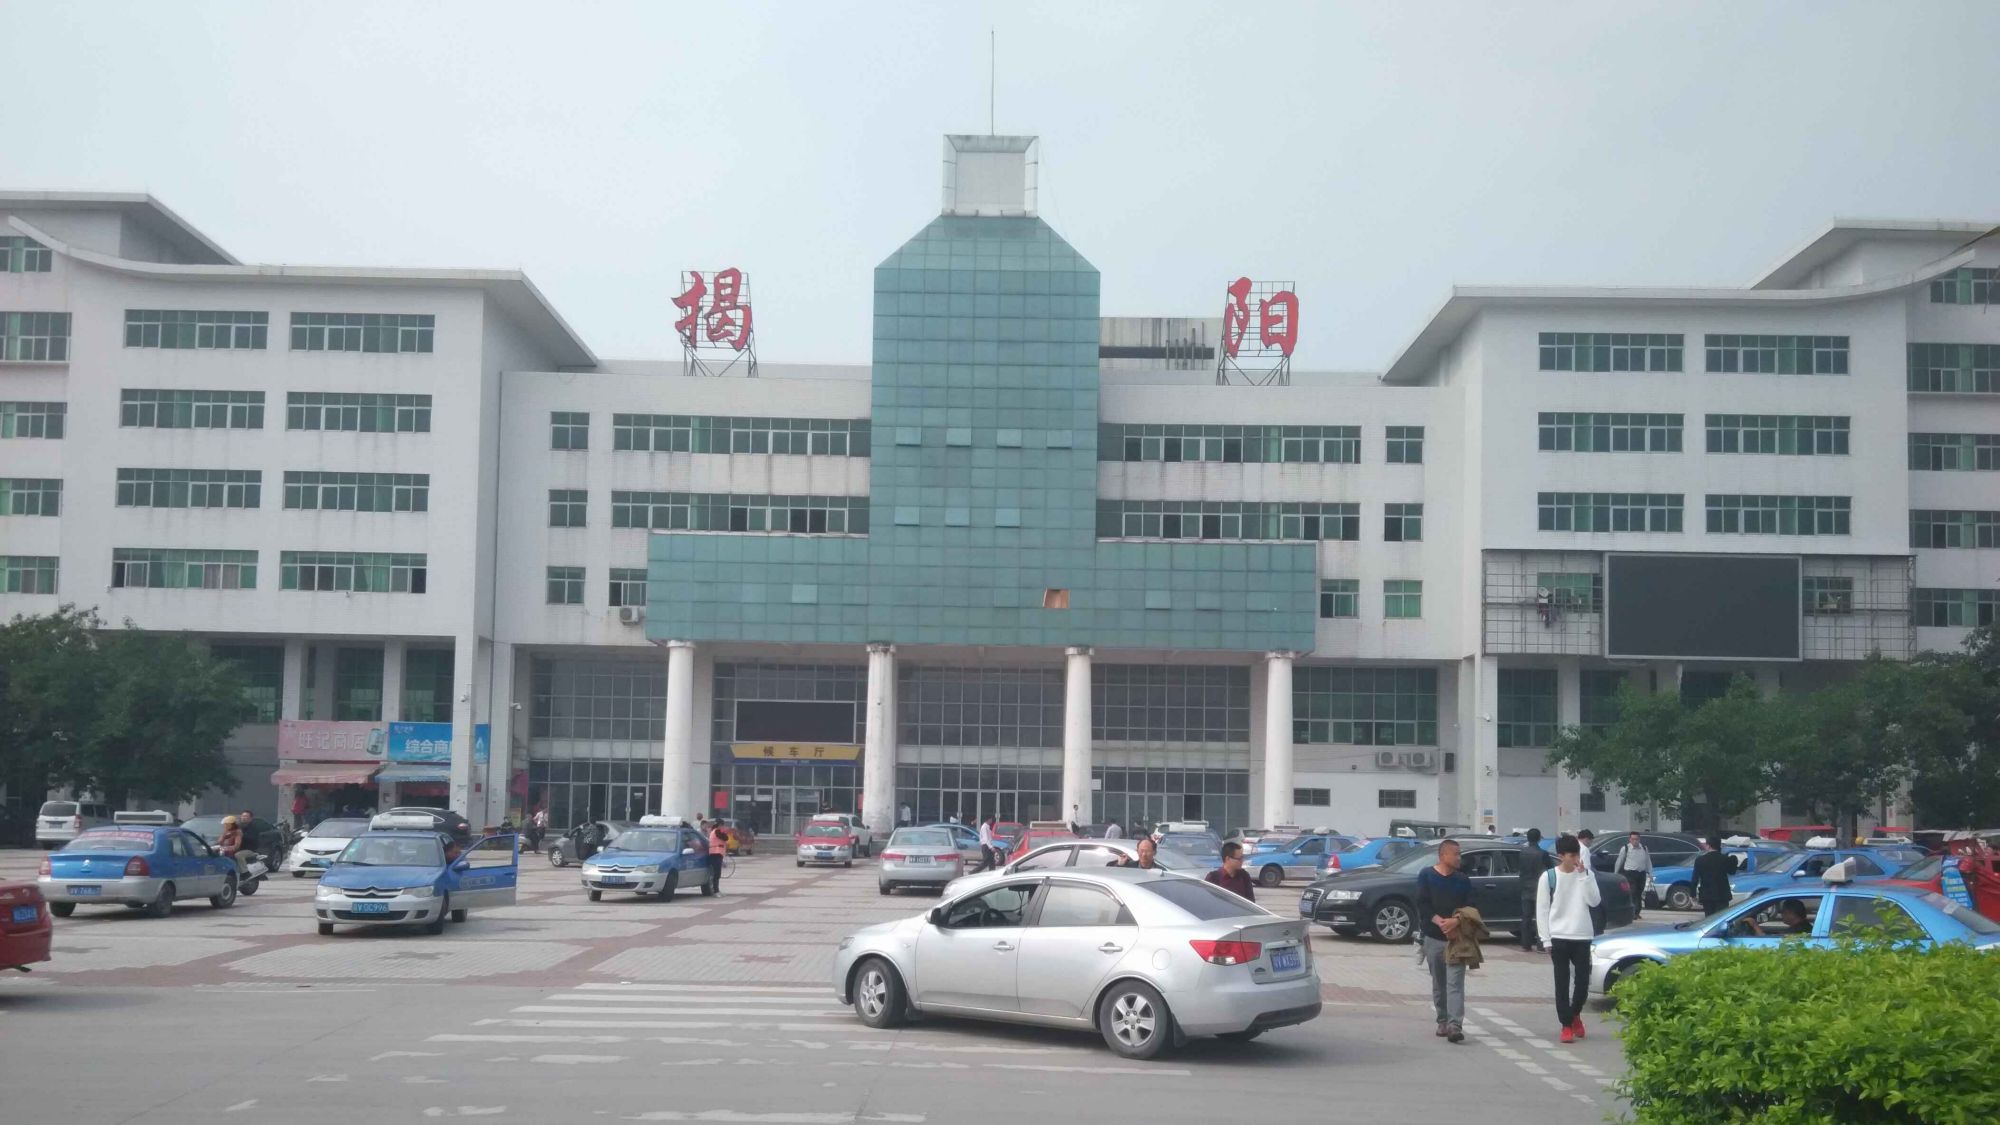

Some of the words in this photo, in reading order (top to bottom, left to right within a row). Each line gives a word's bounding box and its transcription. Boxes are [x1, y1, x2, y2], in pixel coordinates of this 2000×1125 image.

[671, 267, 752, 352] 揭
[1224, 277, 1299, 358] 阳
[299, 730, 366, 750] 旺记商店
[405, 739, 452, 754] 综合商
[763, 745, 825, 758] 候车厅
